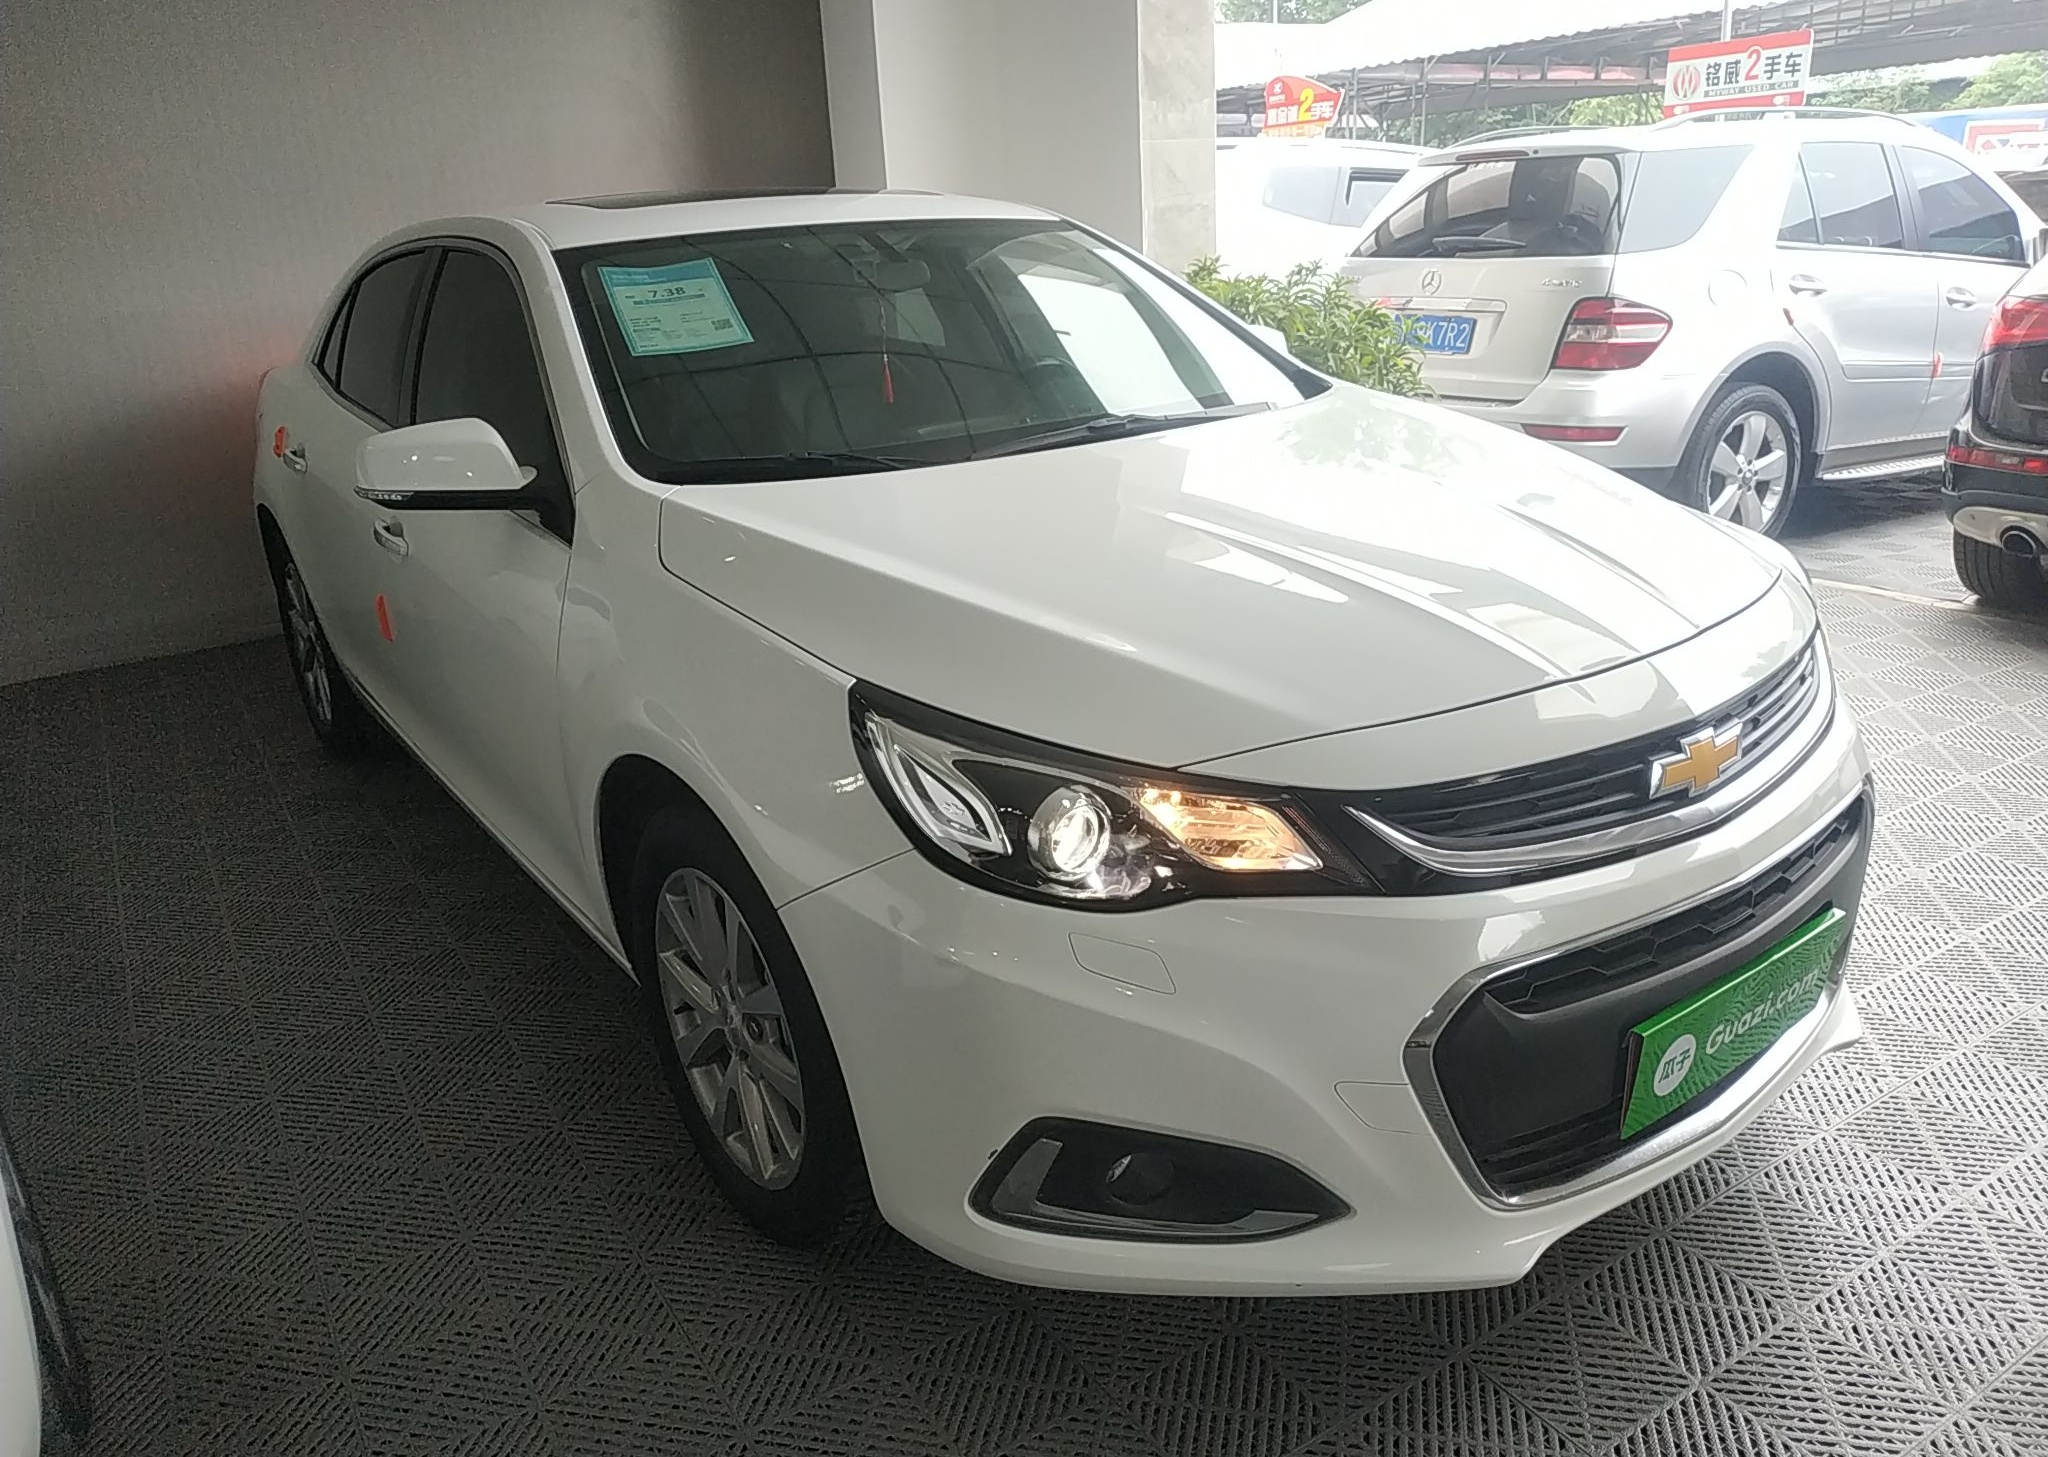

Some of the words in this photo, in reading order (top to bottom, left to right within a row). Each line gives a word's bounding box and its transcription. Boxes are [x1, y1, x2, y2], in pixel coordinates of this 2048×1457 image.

[1705, 48, 1803, 87] 铭威2手车
[1744, 83, 1770, 93] USED
[1774, 80, 1794, 90] CAR
[647, 286, 686, 299] 7.38
[1705, 968, 1819, 1055] Guazi.com
[1657, 1047, 1692, 1084] 瓜子
